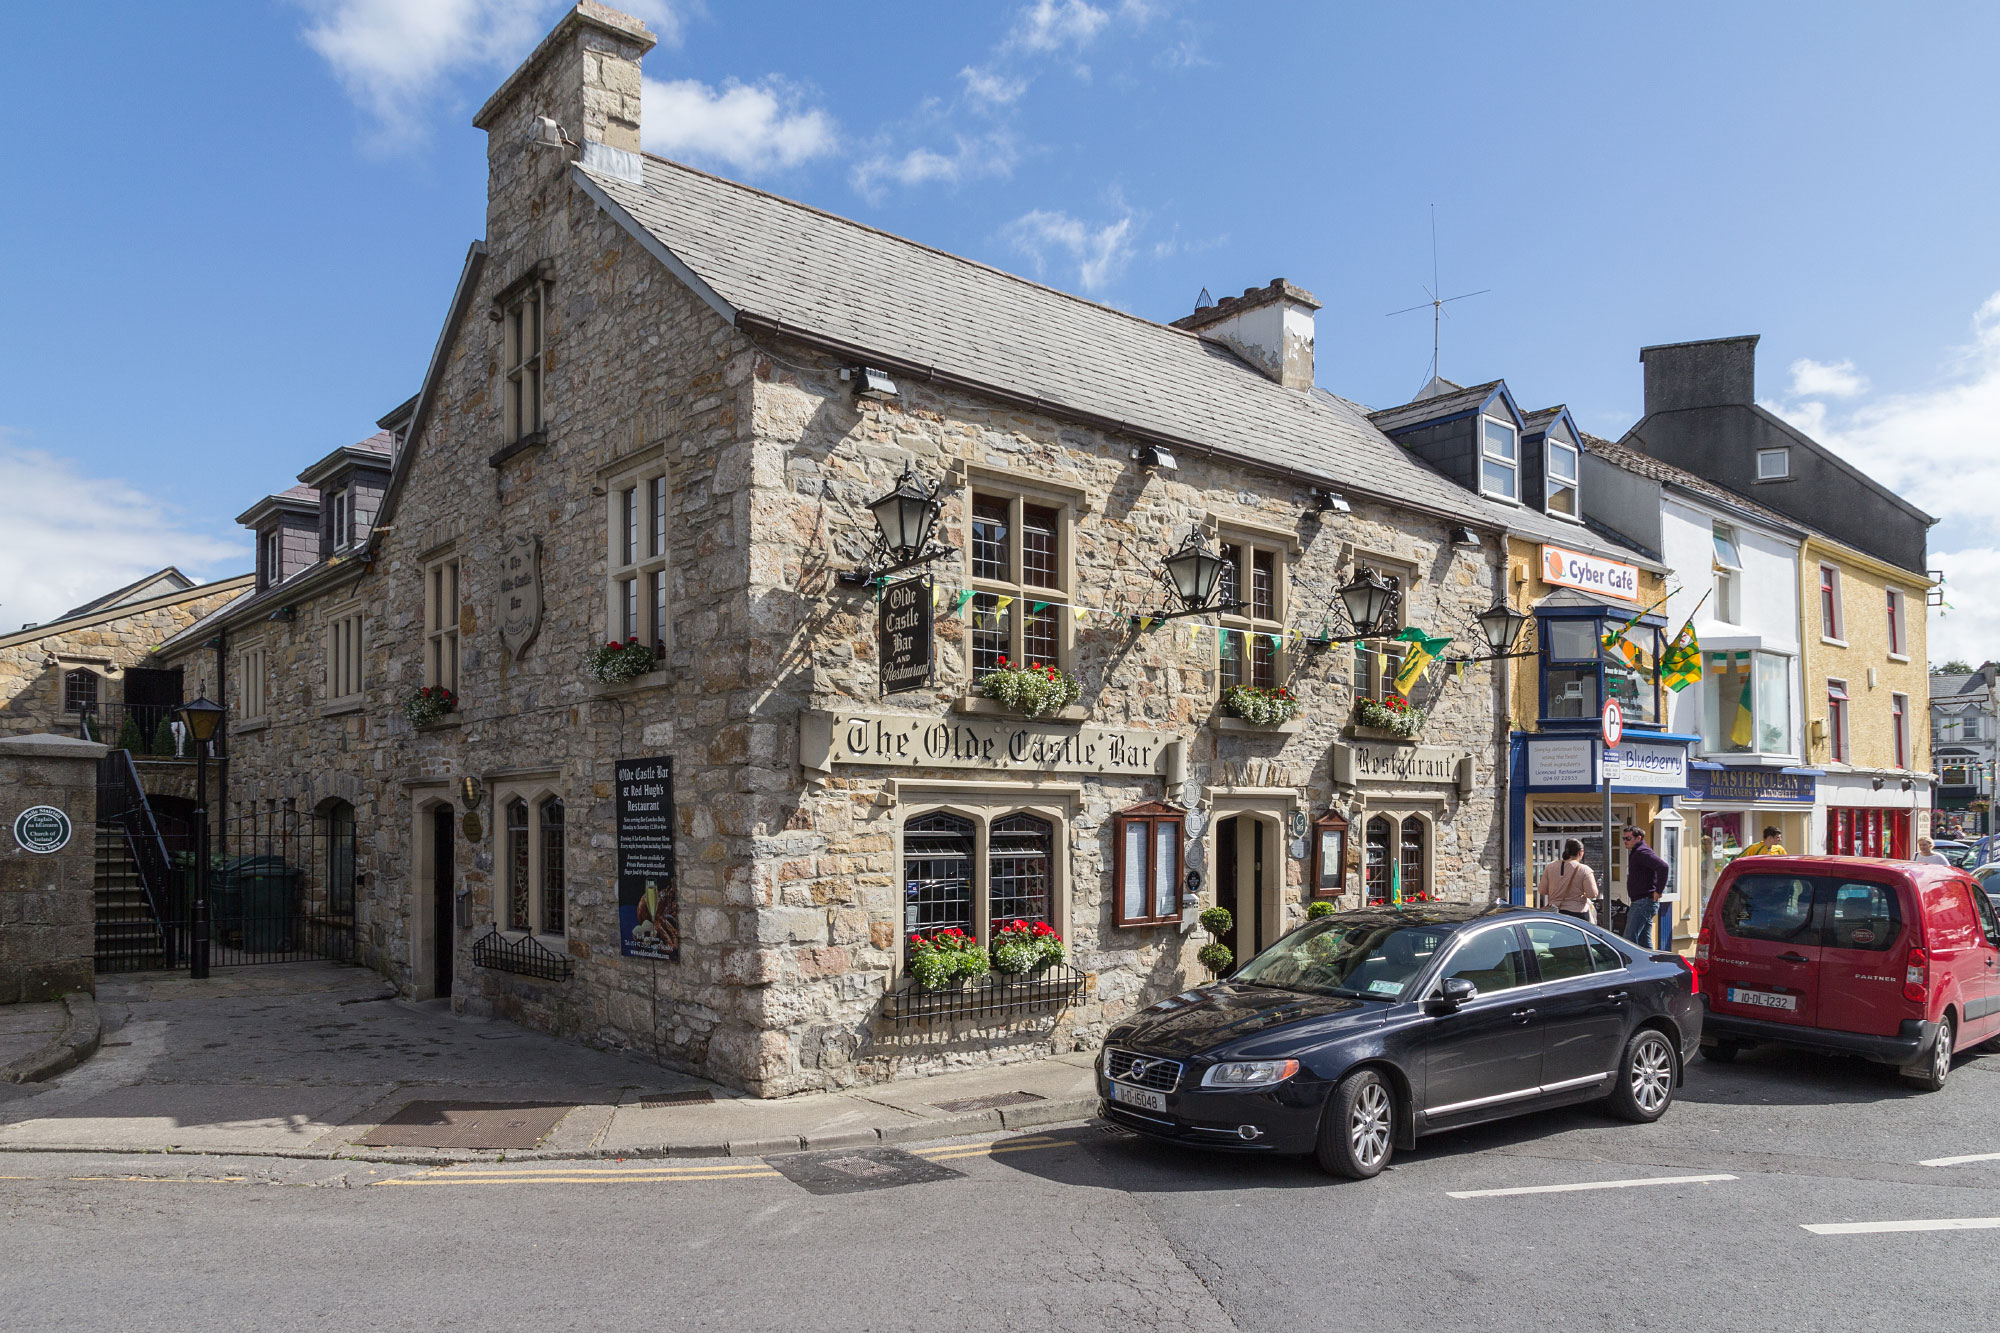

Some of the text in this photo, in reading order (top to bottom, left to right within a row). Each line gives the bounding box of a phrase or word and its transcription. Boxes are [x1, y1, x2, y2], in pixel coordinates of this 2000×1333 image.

[1569, 560, 1633, 591] Cyber Café
[890, 586, 916, 609] Olde
[886, 606, 919, 632] Castle
[892, 632, 914, 657] Bar
[896, 654, 911, 663] AND
[880, 658, 931, 683] Restaurant
[846, 717, 1152, 767] The Olde Castle Bar
[1358, 747, 1451, 777] Restaurant
[1626, 749, 1682, 775] Blueberry
[618, 765, 669, 782] Olde Castle Bar
[1710, 770, 1799, 789] MASTERCLEAN
[623, 784, 664, 797] & Red Hugh's
[1710, 787, 1752, 797] DRYCLEANERS
[627, 800, 660, 812] Restaurant
[1711, 955, 1751, 966] PEUGEOT
[1855, 973, 1897, 982] PARTNER
[1741, 992, 1788, 1008] 10-DL-1232
